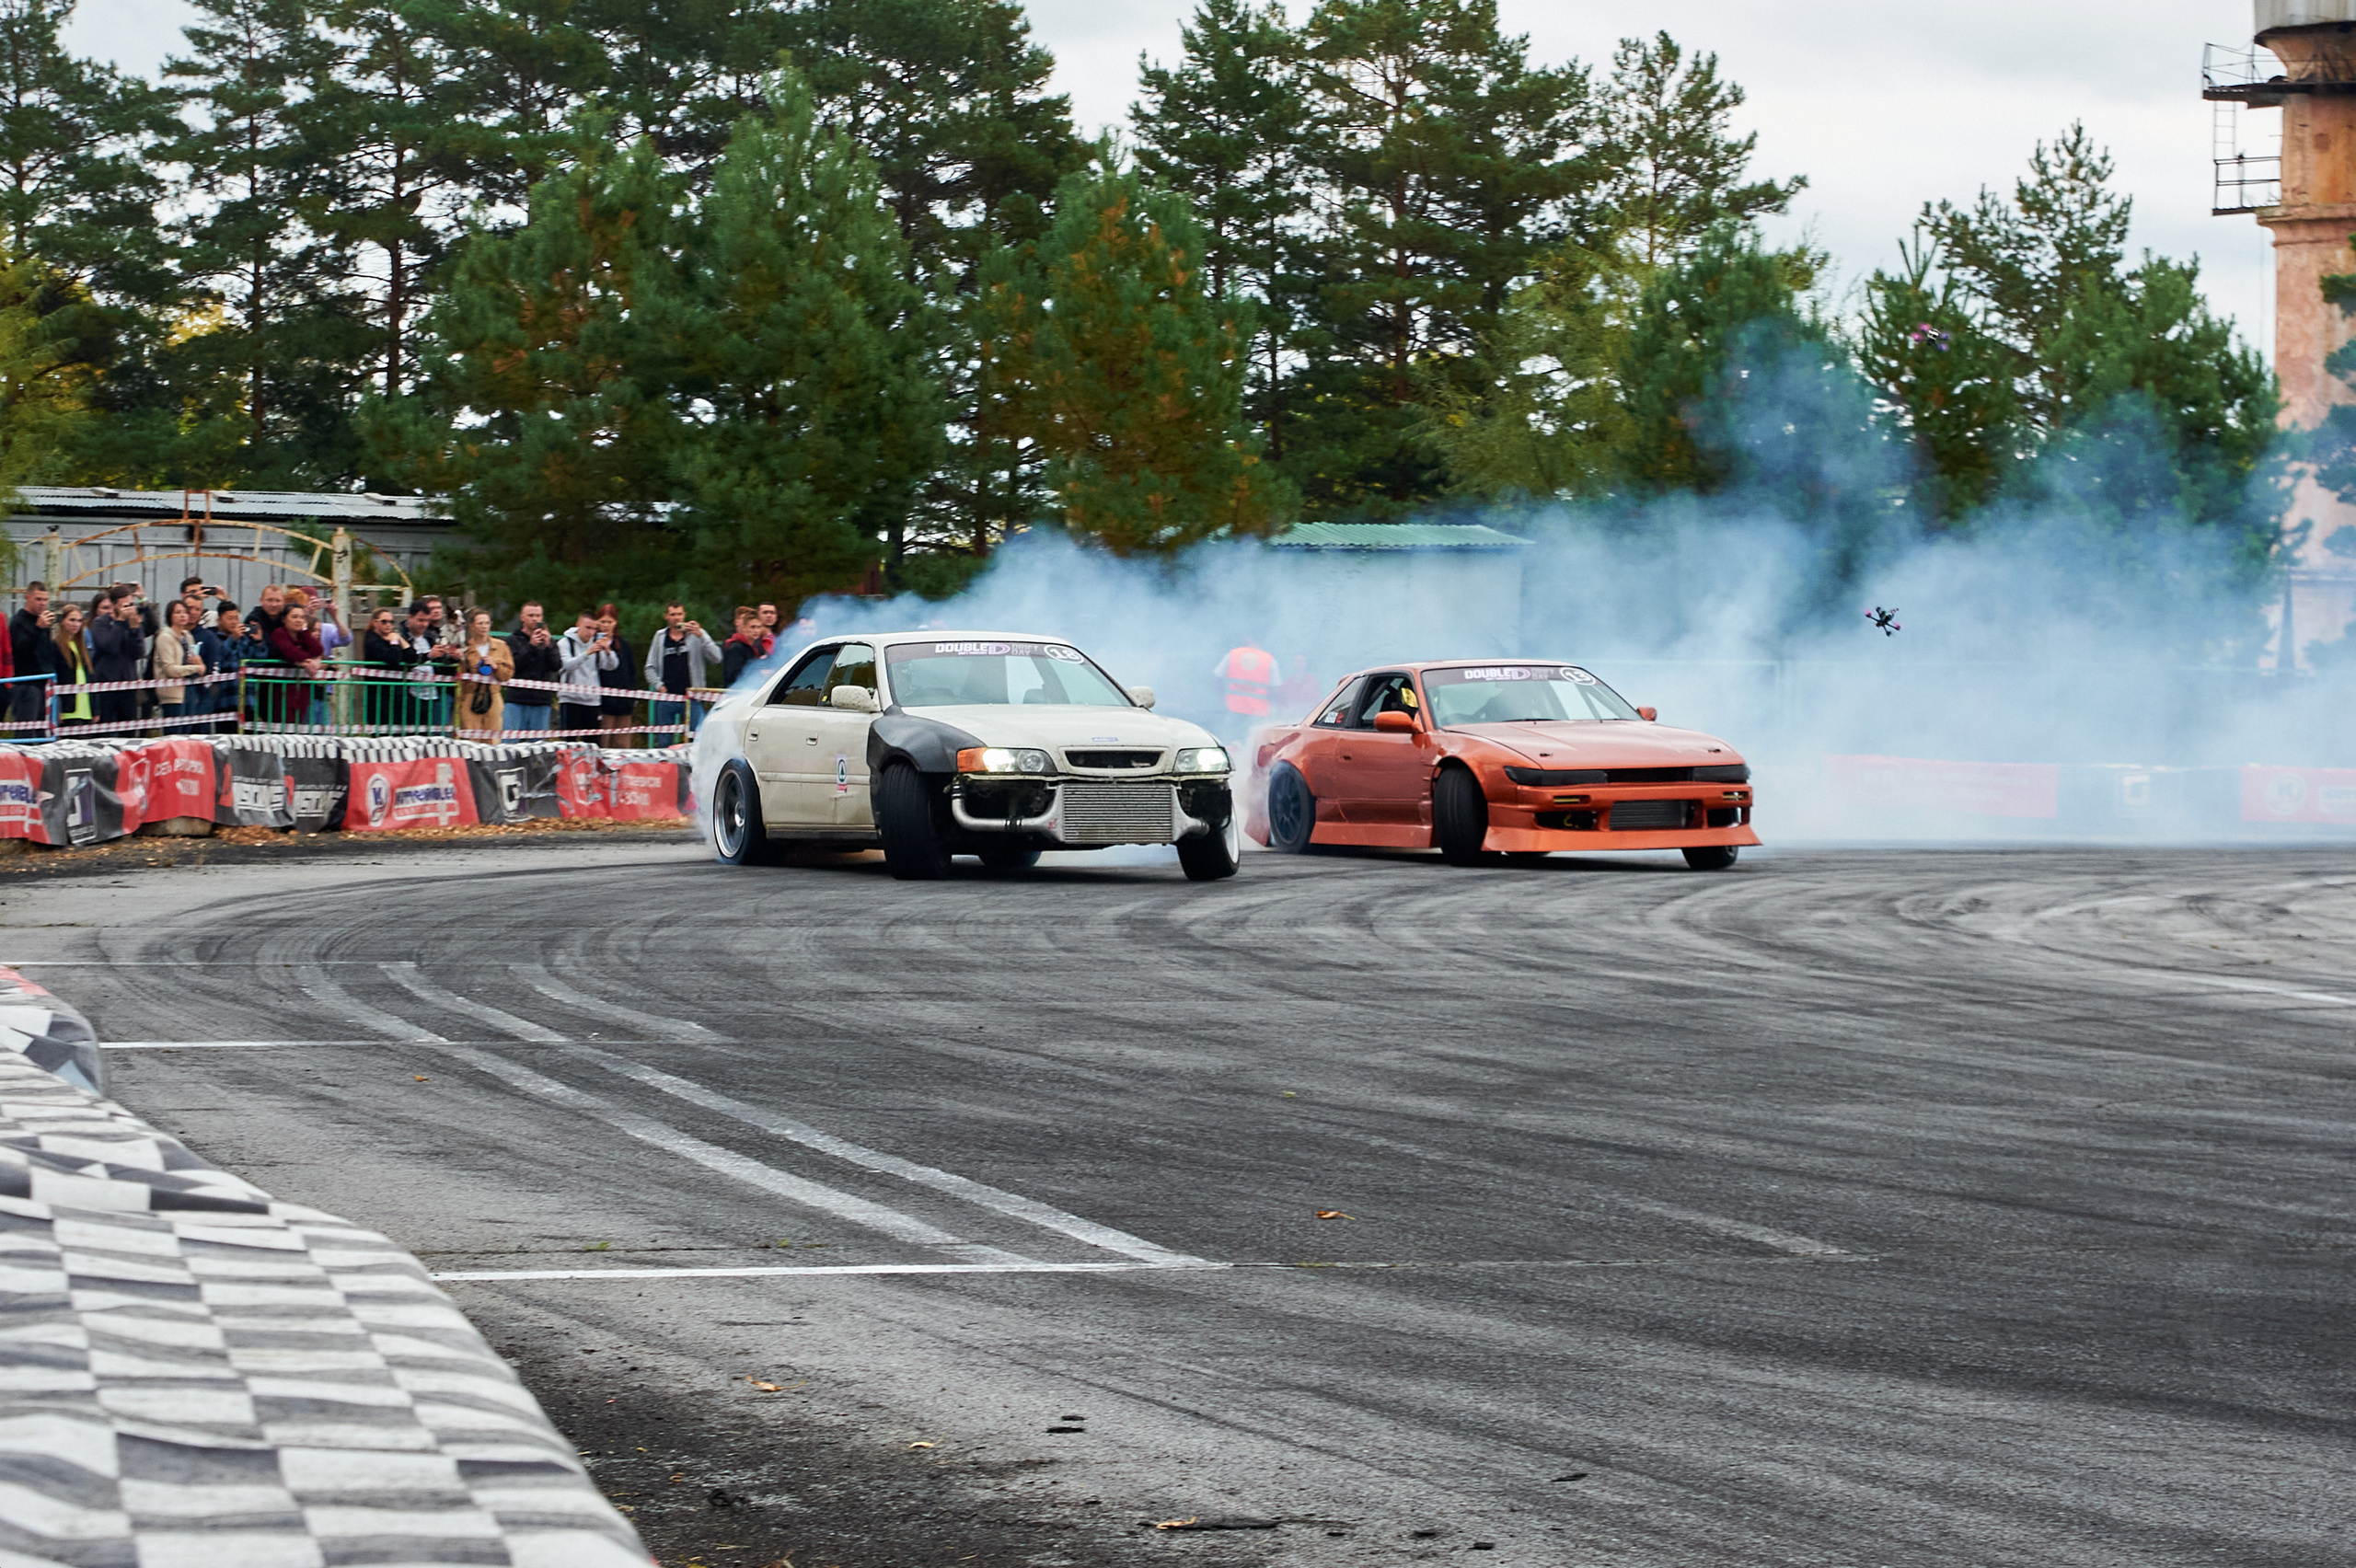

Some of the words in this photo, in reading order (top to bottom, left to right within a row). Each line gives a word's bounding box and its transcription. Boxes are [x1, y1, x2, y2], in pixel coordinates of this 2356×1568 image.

[935, 643, 988, 653] DOUBLE
[1011, 643, 1039, 651] DRIFT
[1049, 648, 1079, 661] 18
[1464, 668, 1511, 679] DOUBLE
[1565, 670, 1591, 683] 13
